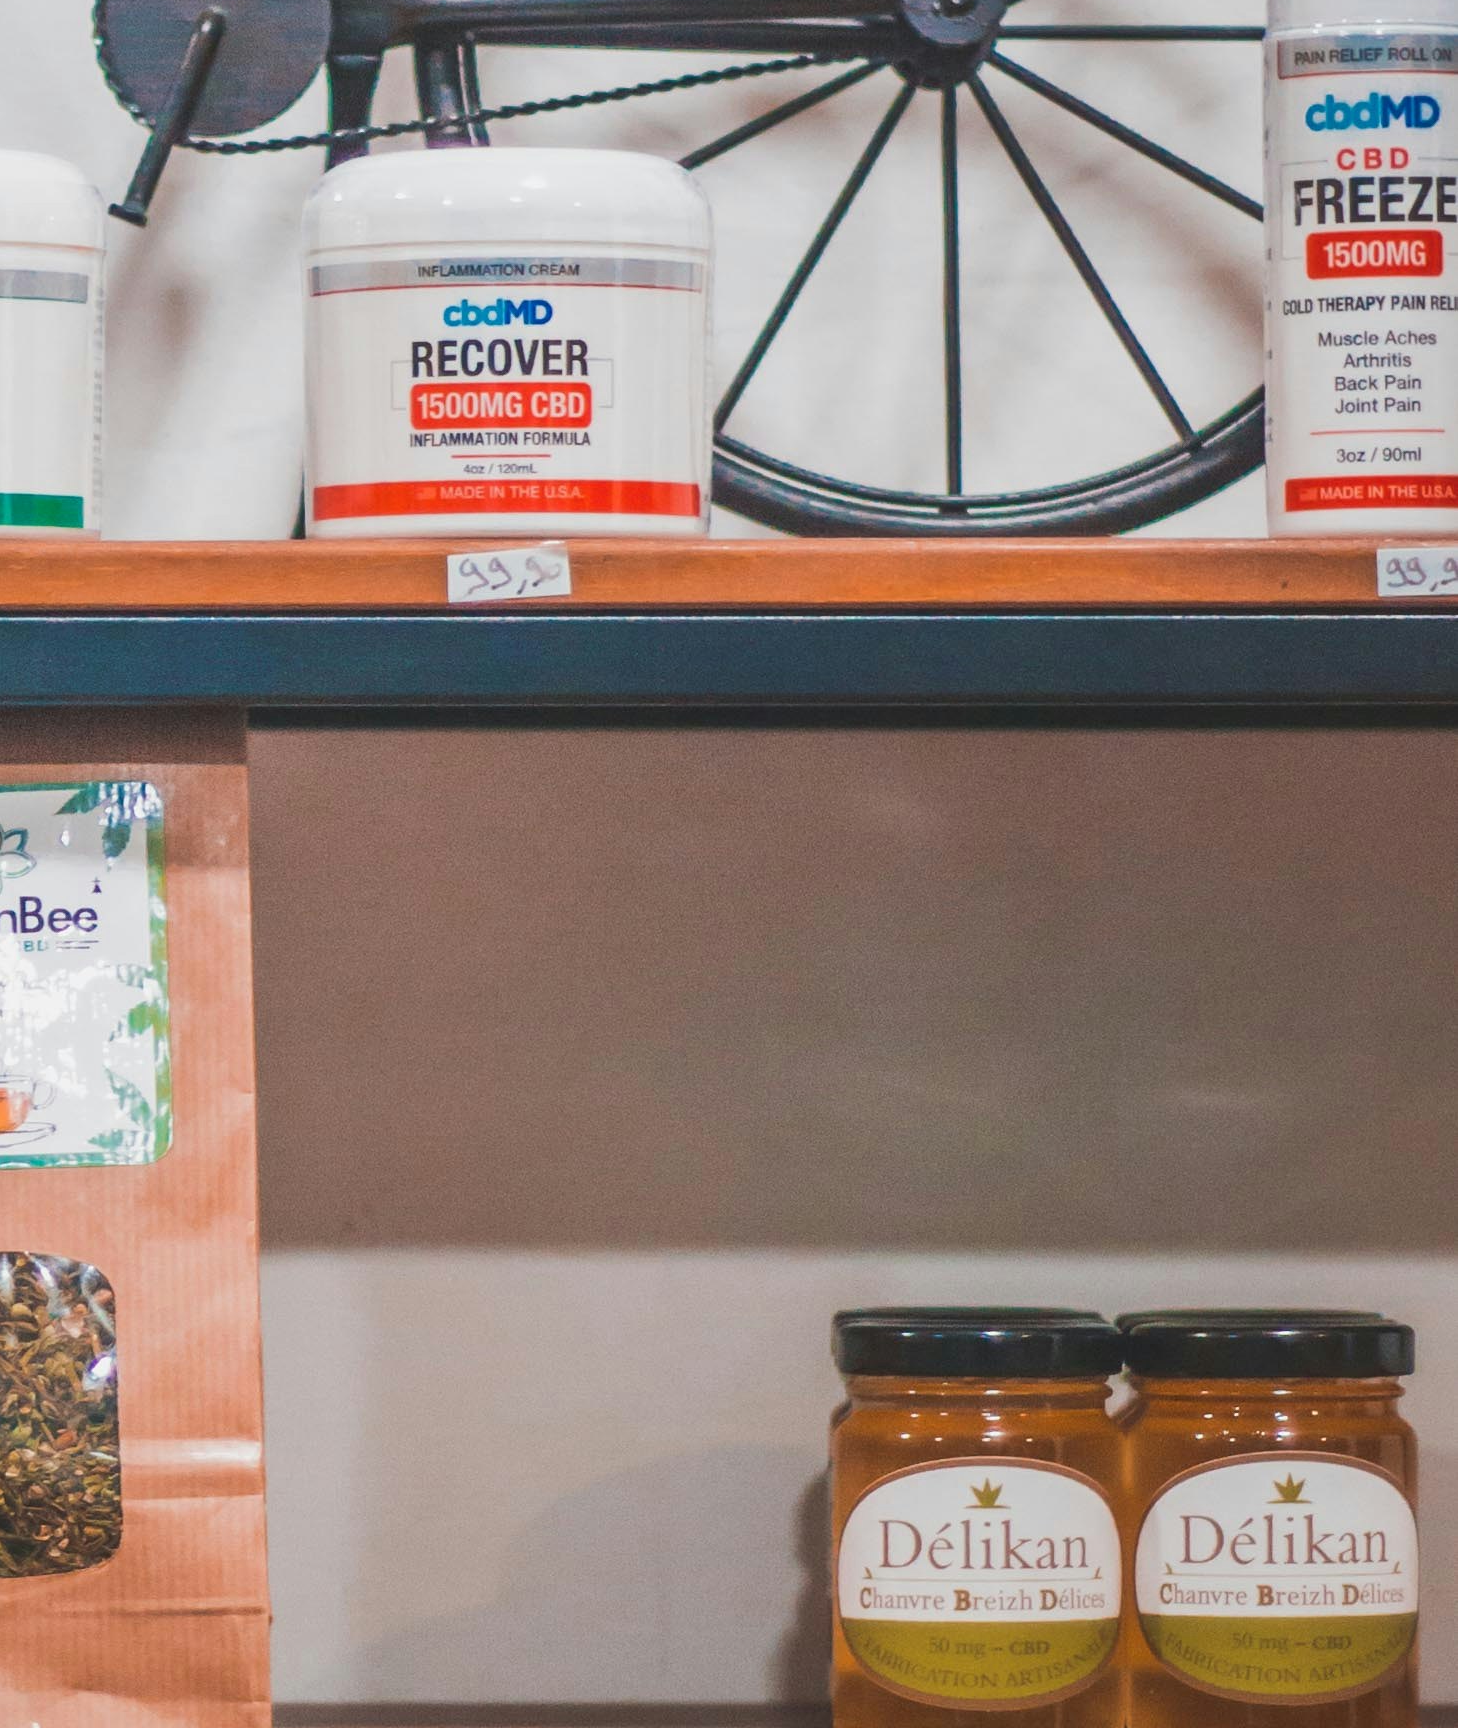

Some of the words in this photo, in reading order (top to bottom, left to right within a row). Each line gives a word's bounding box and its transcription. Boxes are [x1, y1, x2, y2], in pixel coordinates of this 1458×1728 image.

[1294, 51, 1325, 65] PAIN
[1330, 48, 1383, 63] RELIEF
[1388, 48, 1428, 61] ROLL
[1432, 48, 1451, 62] ON
[1305, 92, 1441, 131] cbdMD
[1336, 148, 1410, 171] CBD
[1294, 176, 1458, 226] FREEZE
[1323, 240, 1427, 268] 1500MG
[417, 264, 525, 277] INFLAMMATION
[529, 264, 579, 276] CREAM
[443, 298, 552, 326] cbdMD
[1283, 298, 1313, 315] COLD
[1318, 296, 1385, 312] THERAPY
[1392, 296, 1426, 311] PAIN
[1318, 331, 1378, 346] Muscle
[1385, 331, 1437, 345] Aches
[411, 339, 588, 377] RECOVER
[1344, 353, 1412, 368] Arthritis
[1335, 377, 1377, 391] Back
[1385, 376, 1421, 389] Pain
[417, 392, 522, 419] 1500MG
[531, 393, 585, 417] CBD
[1335, 398, 1378, 413] Joint
[1385, 398, 1421, 412] Pain
[410, 432, 517, 447] INFLAMMATION
[524, 432, 590, 446] FORMULA
[1336, 448, 1366, 462] 3oz
[1383, 447, 1421, 461] 90ml
[464, 464, 485, 474] 4oz
[440, 486, 485, 498] MADE
[489, 486, 505, 498] IN
[510, 486, 539, 498] THE
[1320, 486, 1363, 499] MADE
[1368, 486, 1383, 498] IN
[1388, 486, 1416, 498] THE
[878, 1519, 1088, 1570] Délikan
[1179, 1514, 1388, 1565] Délikan
[860, 1587, 945, 1610] Chanvre
[954, 1588, 1032, 1611] Breizh
[1040, 1589, 1106, 1610] Délices
[1160, 1584, 1247, 1606] Chanvre
[1256, 1584, 1335, 1606] Breizh
[1342, 1583, 1404, 1606] Délices
